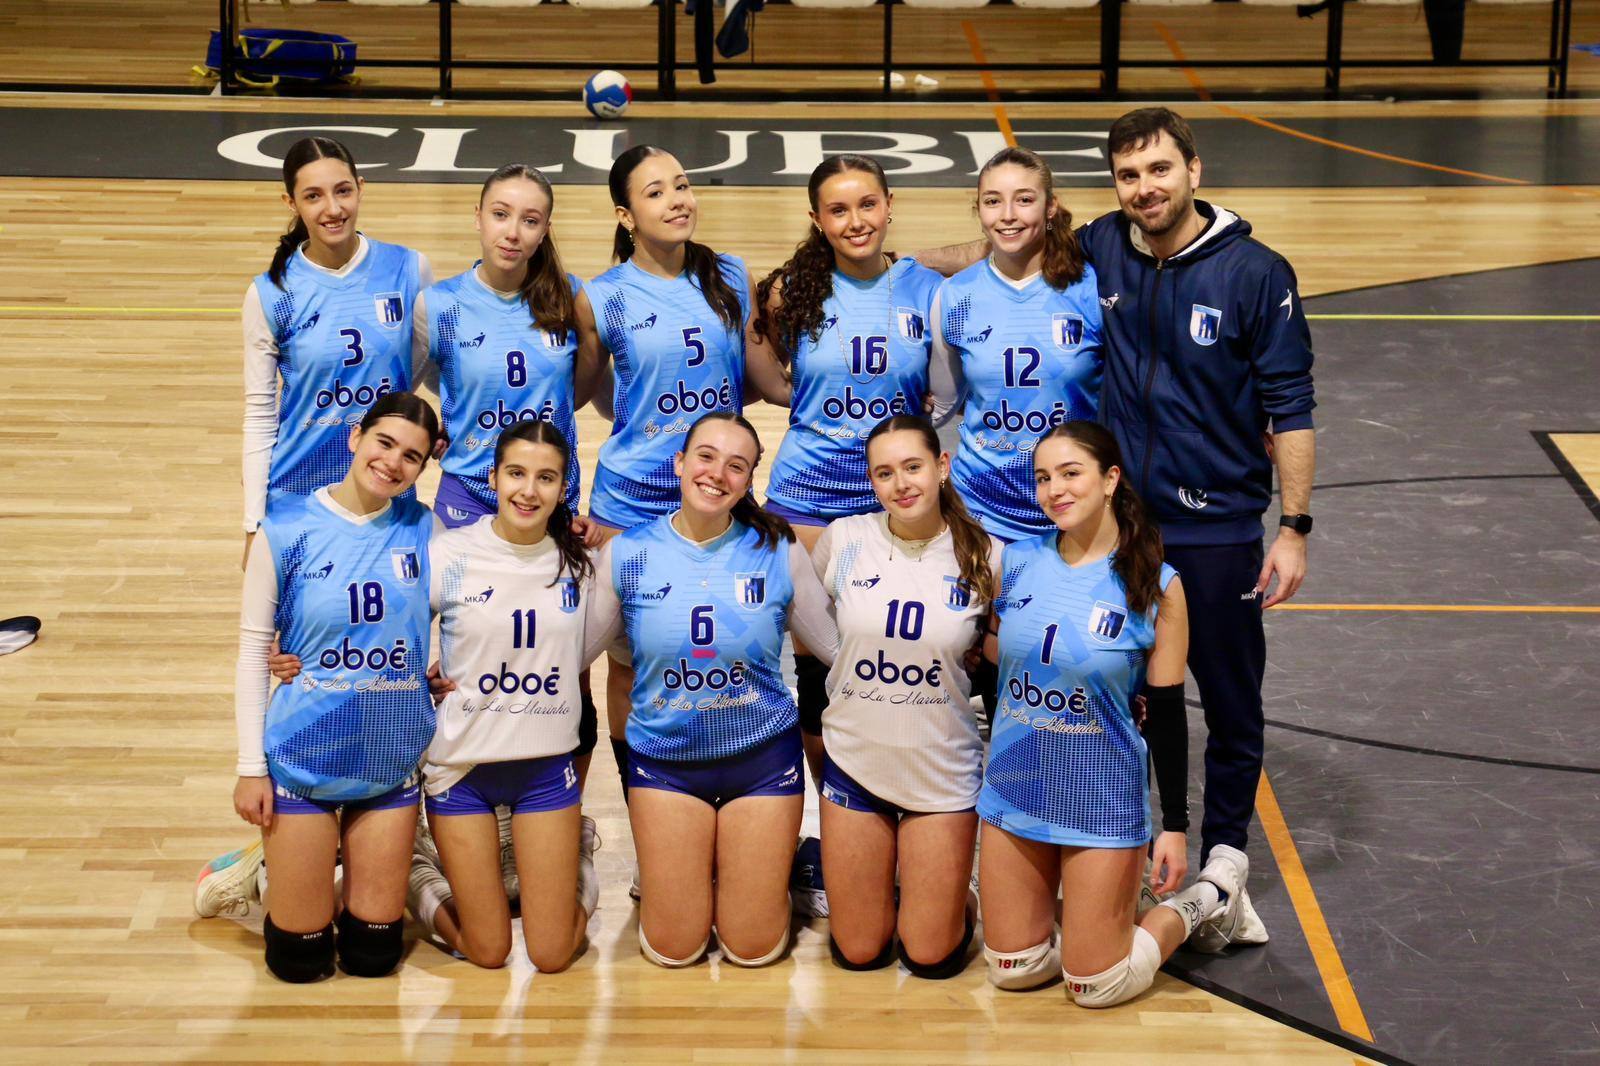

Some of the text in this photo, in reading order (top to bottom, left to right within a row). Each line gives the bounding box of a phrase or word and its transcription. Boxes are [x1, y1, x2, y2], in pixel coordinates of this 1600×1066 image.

[216, 125, 1110, 176] CLUBE
[631, 320, 651, 332] MKA
[339, 326, 366, 368] 3
[459, 341, 478, 349] MKA
[682, 326, 706, 368] 5
[967, 335, 985, 344] MKA
[849, 335, 888, 375] 16
[505, 350, 528, 389] 8
[1002, 346, 1041, 388] 12
[644, 419, 661, 440] by
[827, 423, 856, 439] Lu
[465, 432, 499, 451] by L
[989, 436, 1016, 451] Lu
[303, 571, 323, 581] MKA
[852, 579, 869, 590] MKA
[347, 581, 385, 624] 18
[464, 595, 484, 604] MKA
[642, 592, 662, 601] MKA
[511, 607, 537, 649] 11
[690, 605, 715, 646] 6
[884, 598, 925, 641] 10
[1041, 623, 1060, 665] 1
[301, 674, 422, 692] by Lu Marinho
[842, 682, 856, 699] by
[859, 687, 885, 702] Lu
[462, 698, 571, 717] by Lu Marinho
[670, 695, 694, 711] Lu
[696, 686, 760, 711] Marinho
[1011, 707, 1031, 726] Lu
[1032, 716, 1104, 734] Marinho
